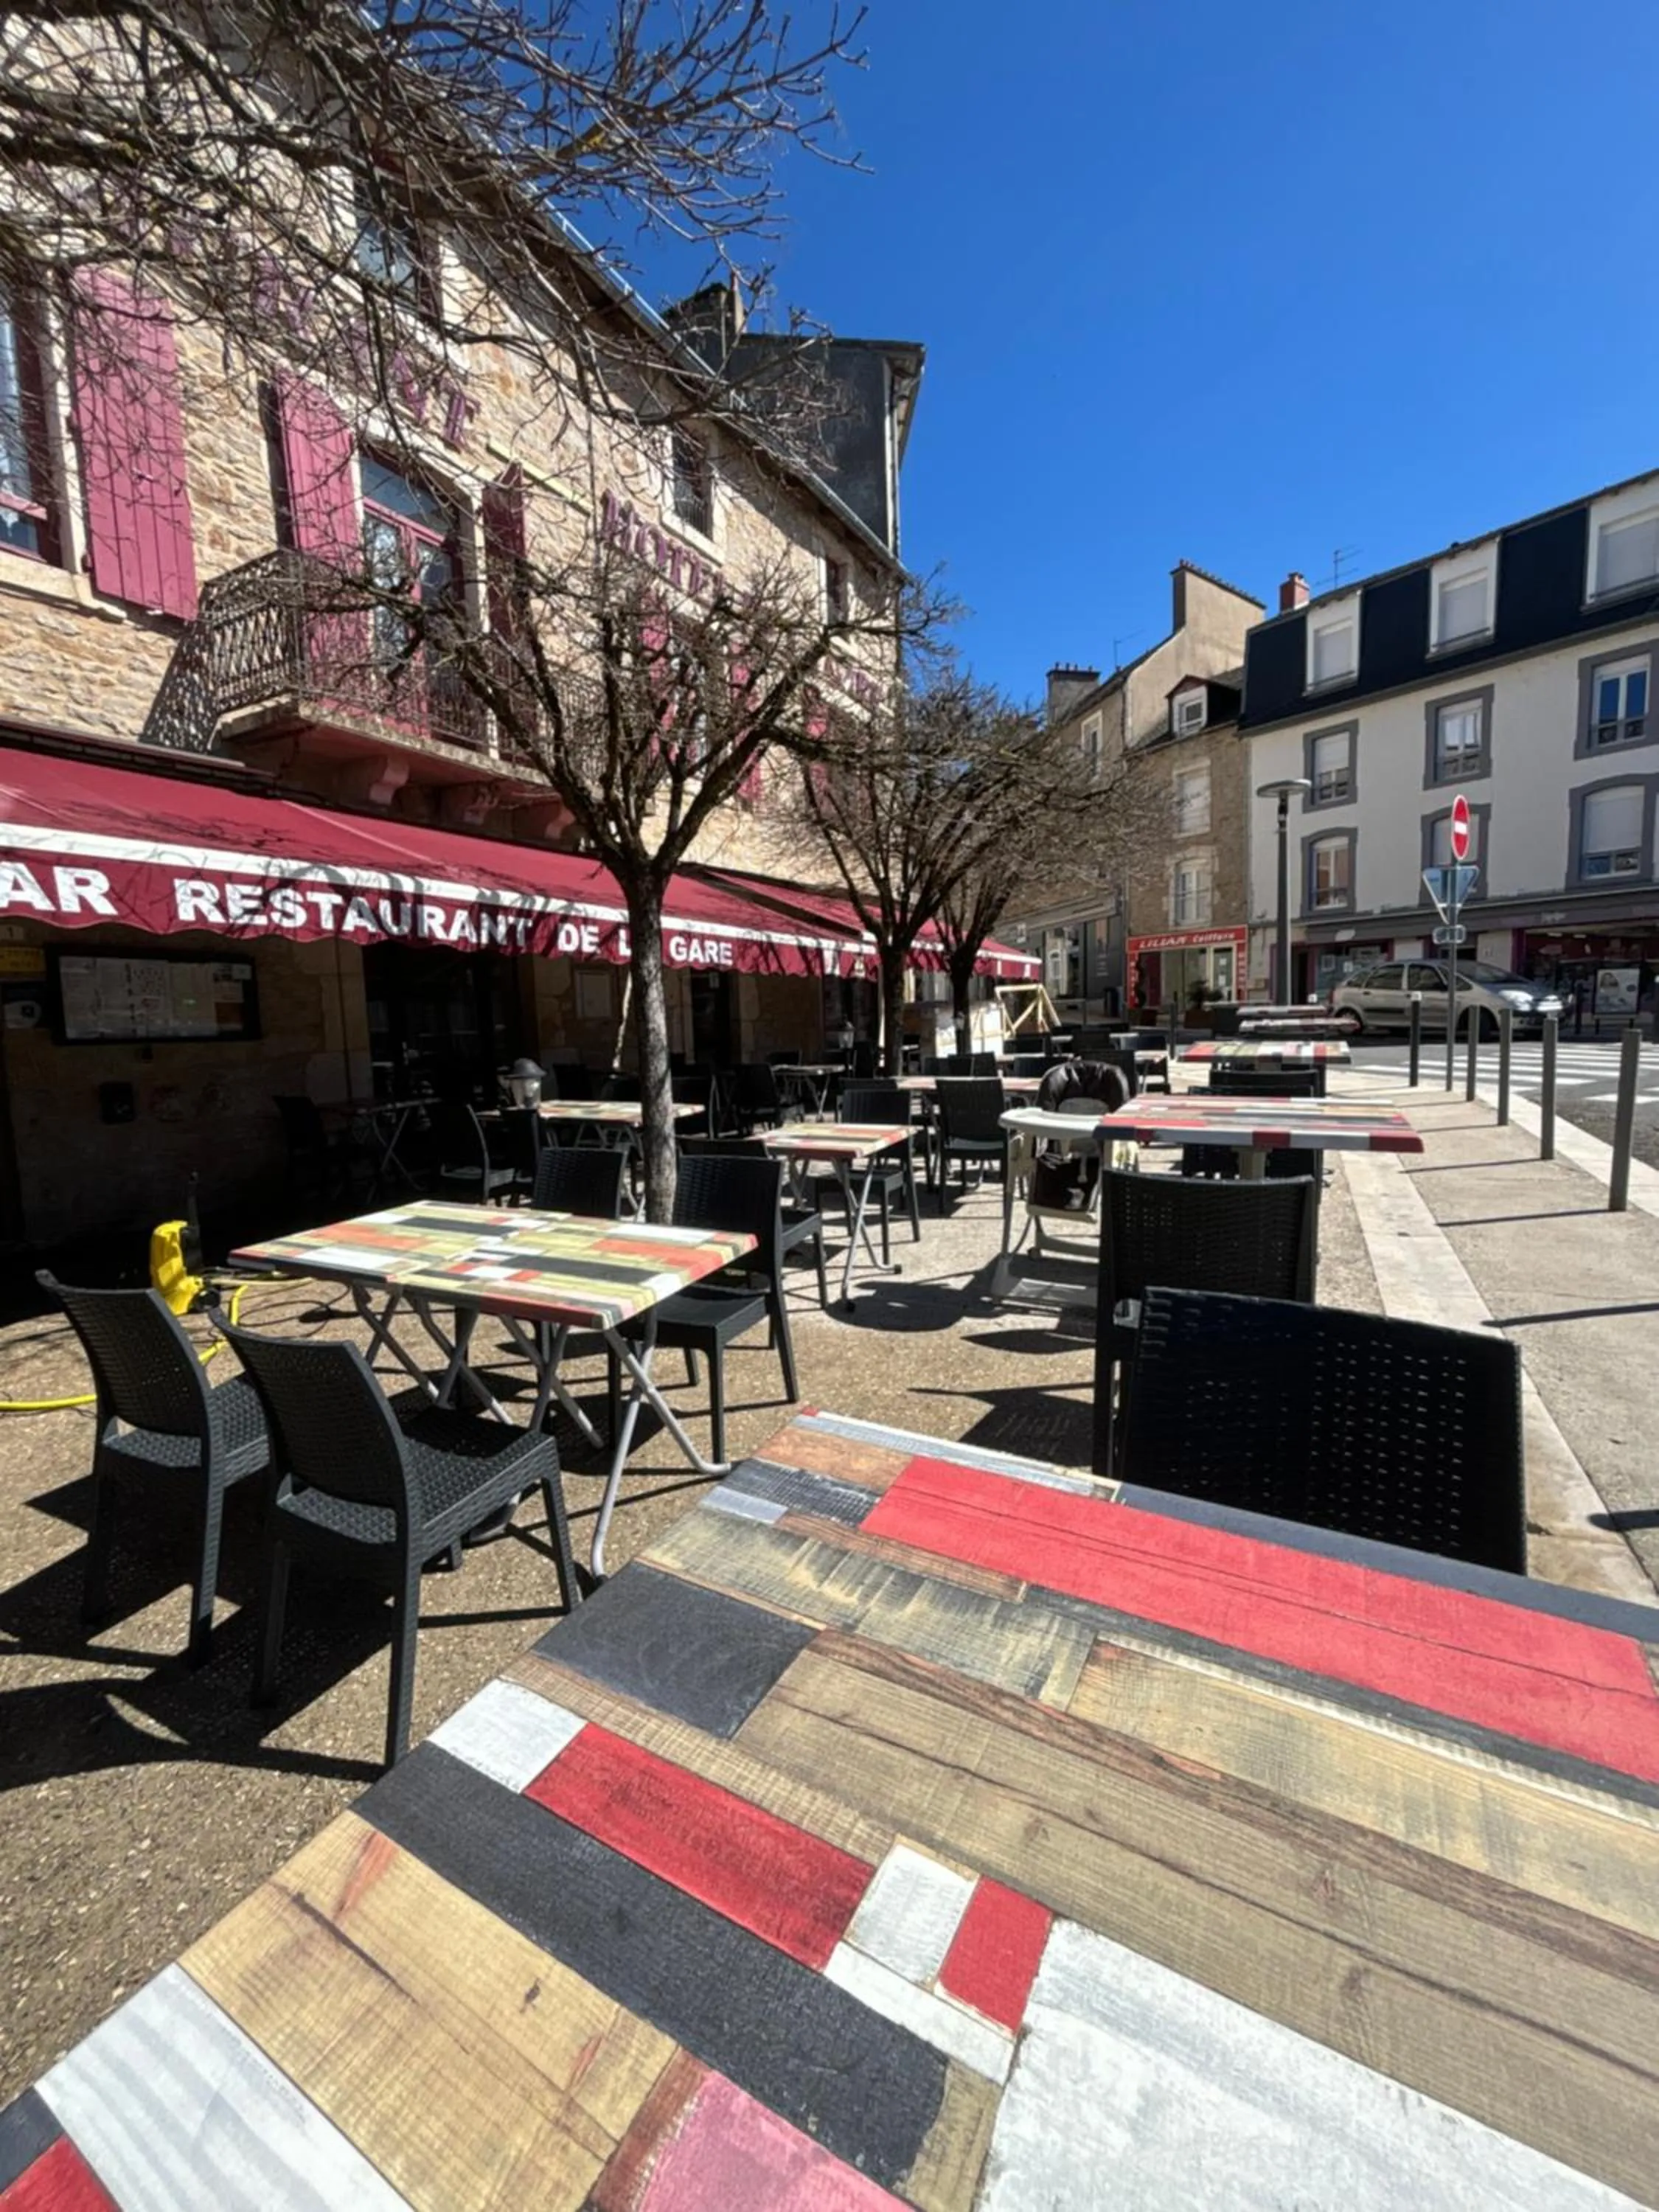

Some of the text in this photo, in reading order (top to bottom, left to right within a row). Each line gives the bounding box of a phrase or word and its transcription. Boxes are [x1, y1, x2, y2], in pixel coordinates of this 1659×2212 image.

[173, 878, 533, 947] RESTAURANT
[557, 922, 600, 953] DE
[669, 936, 733, 966] GARE
